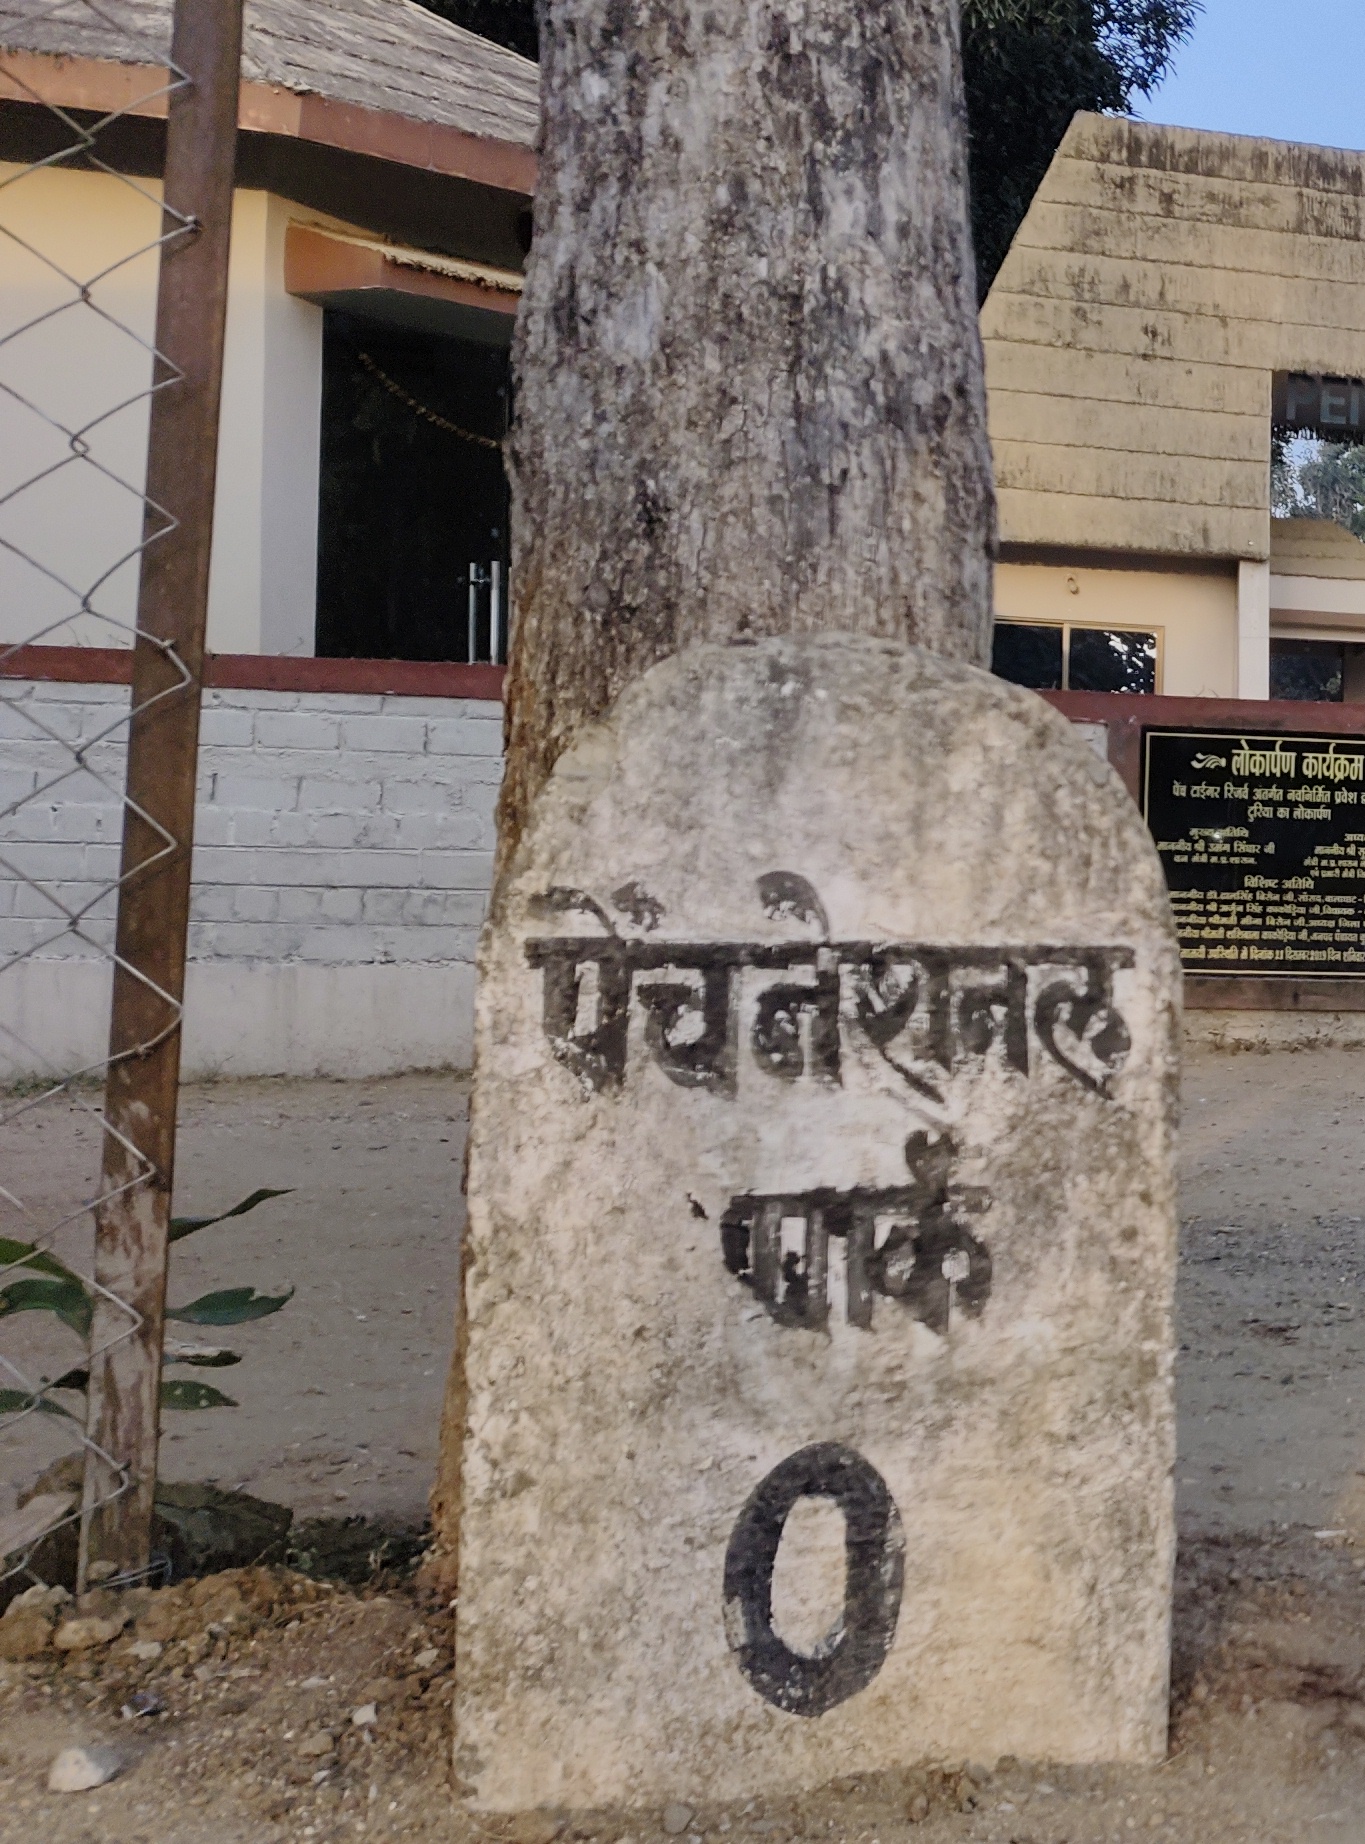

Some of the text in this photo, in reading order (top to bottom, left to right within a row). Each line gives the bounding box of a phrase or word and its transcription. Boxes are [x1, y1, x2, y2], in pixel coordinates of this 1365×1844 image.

[1231, 739, 1365, 783] लोकार्पण कार्यक्रम
[1277, 807, 1290, 819] का
[1292, 803, 1332, 820] लोकार्पण
[1286, 785, 1331, 803] नवनिर्मित
[1334, 787, 1357, 804] प्रवेश
[720, 1128, 993, 1334] पार्क
[723, 1441, 905, 1717] 0
